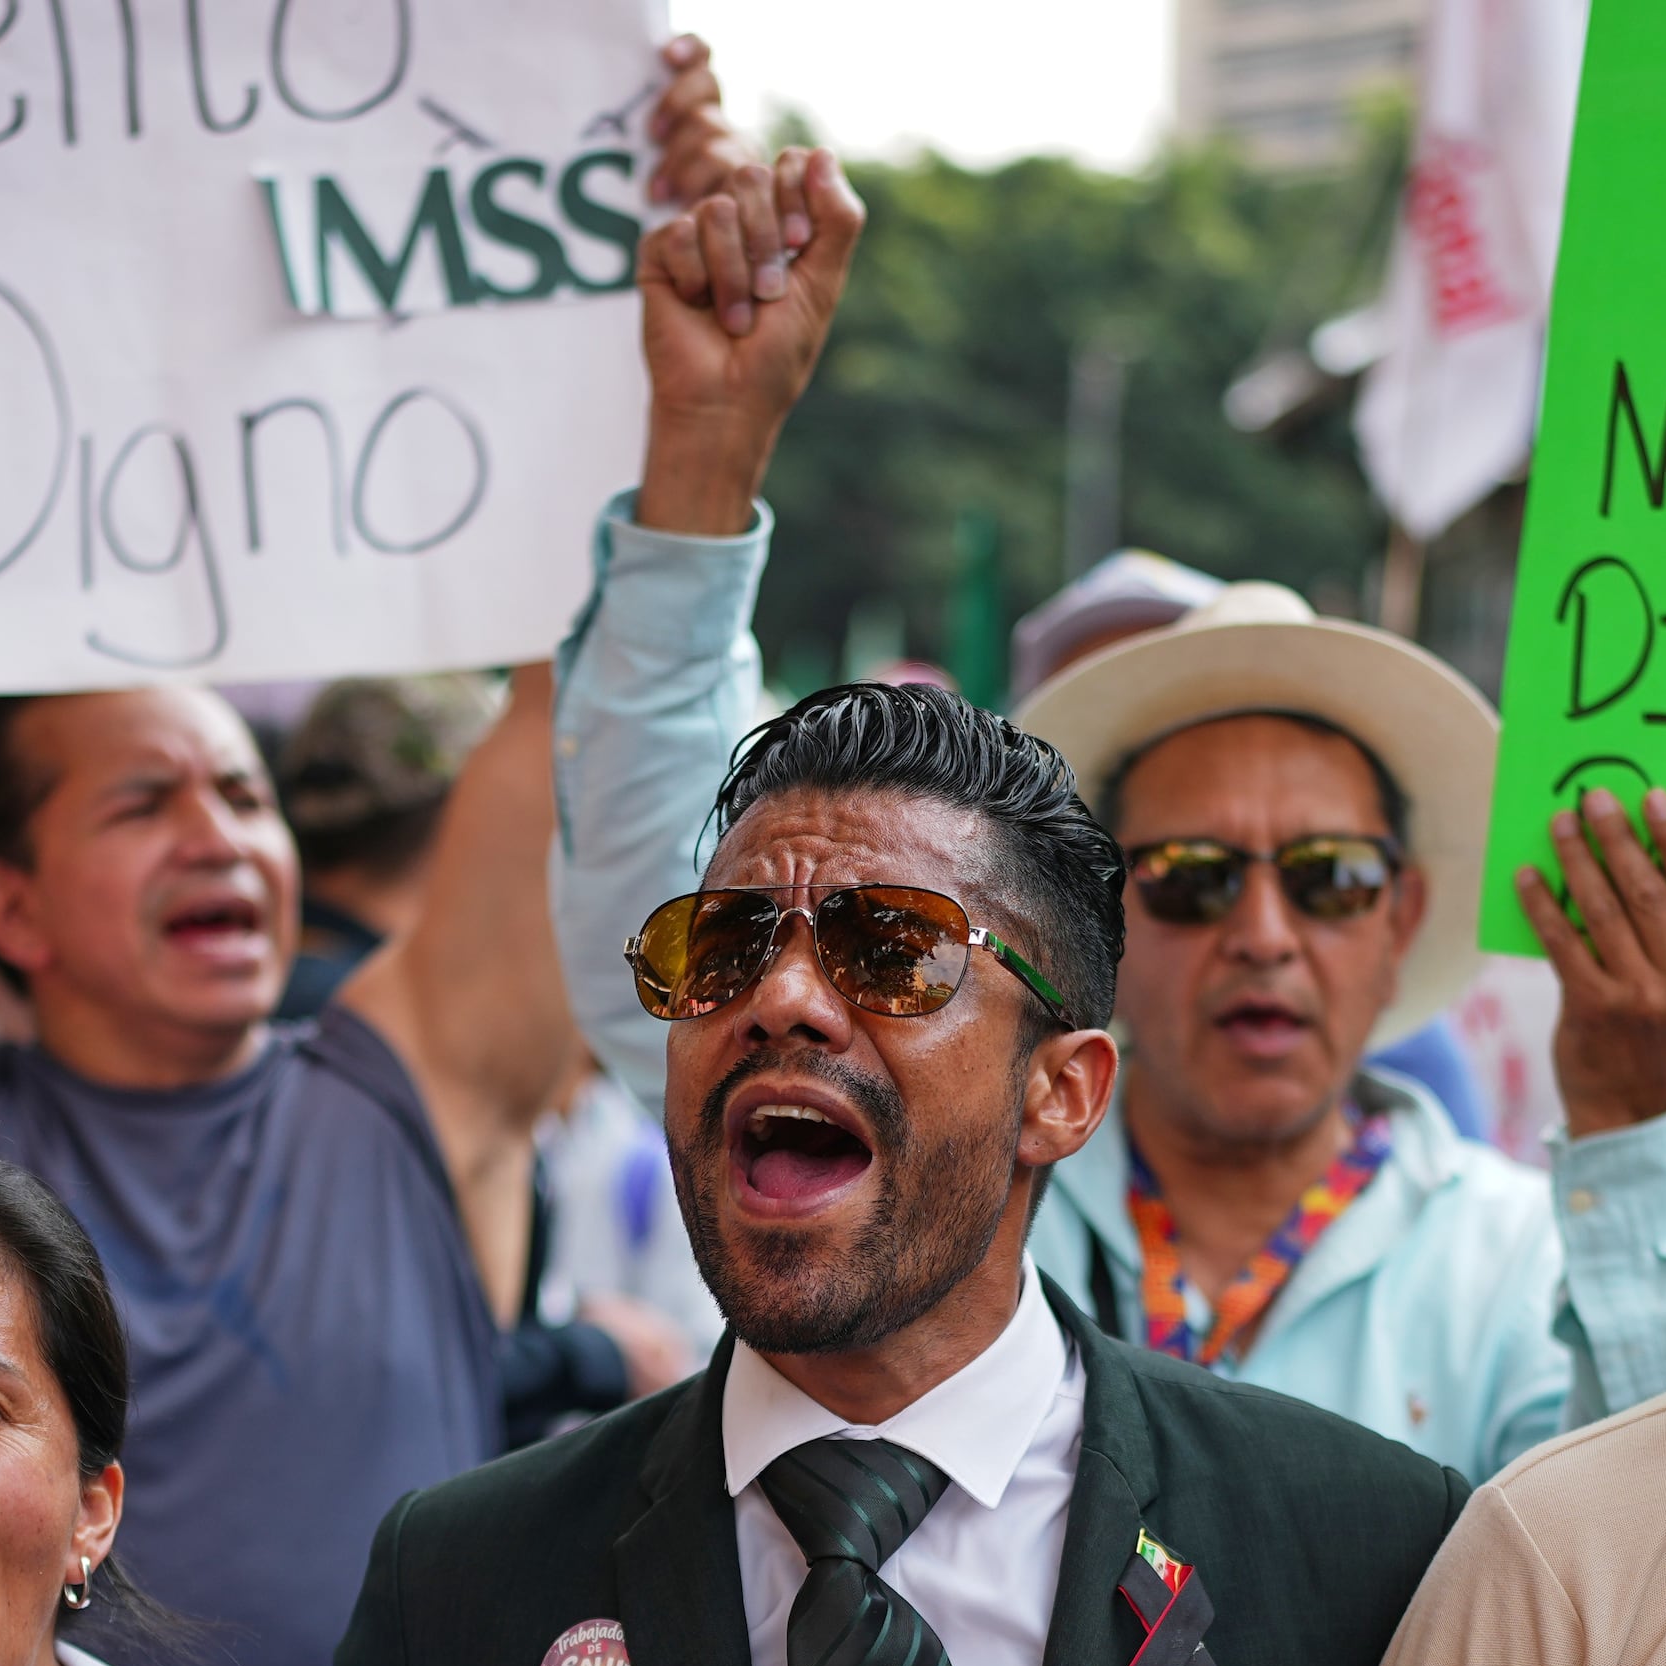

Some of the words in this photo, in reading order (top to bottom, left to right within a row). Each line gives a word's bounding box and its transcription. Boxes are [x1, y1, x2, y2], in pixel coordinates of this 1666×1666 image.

[253, 148, 641, 312] IMSS
[554, 1622, 626, 1656] Trabajado
[587, 1642, 602, 1655] DE
